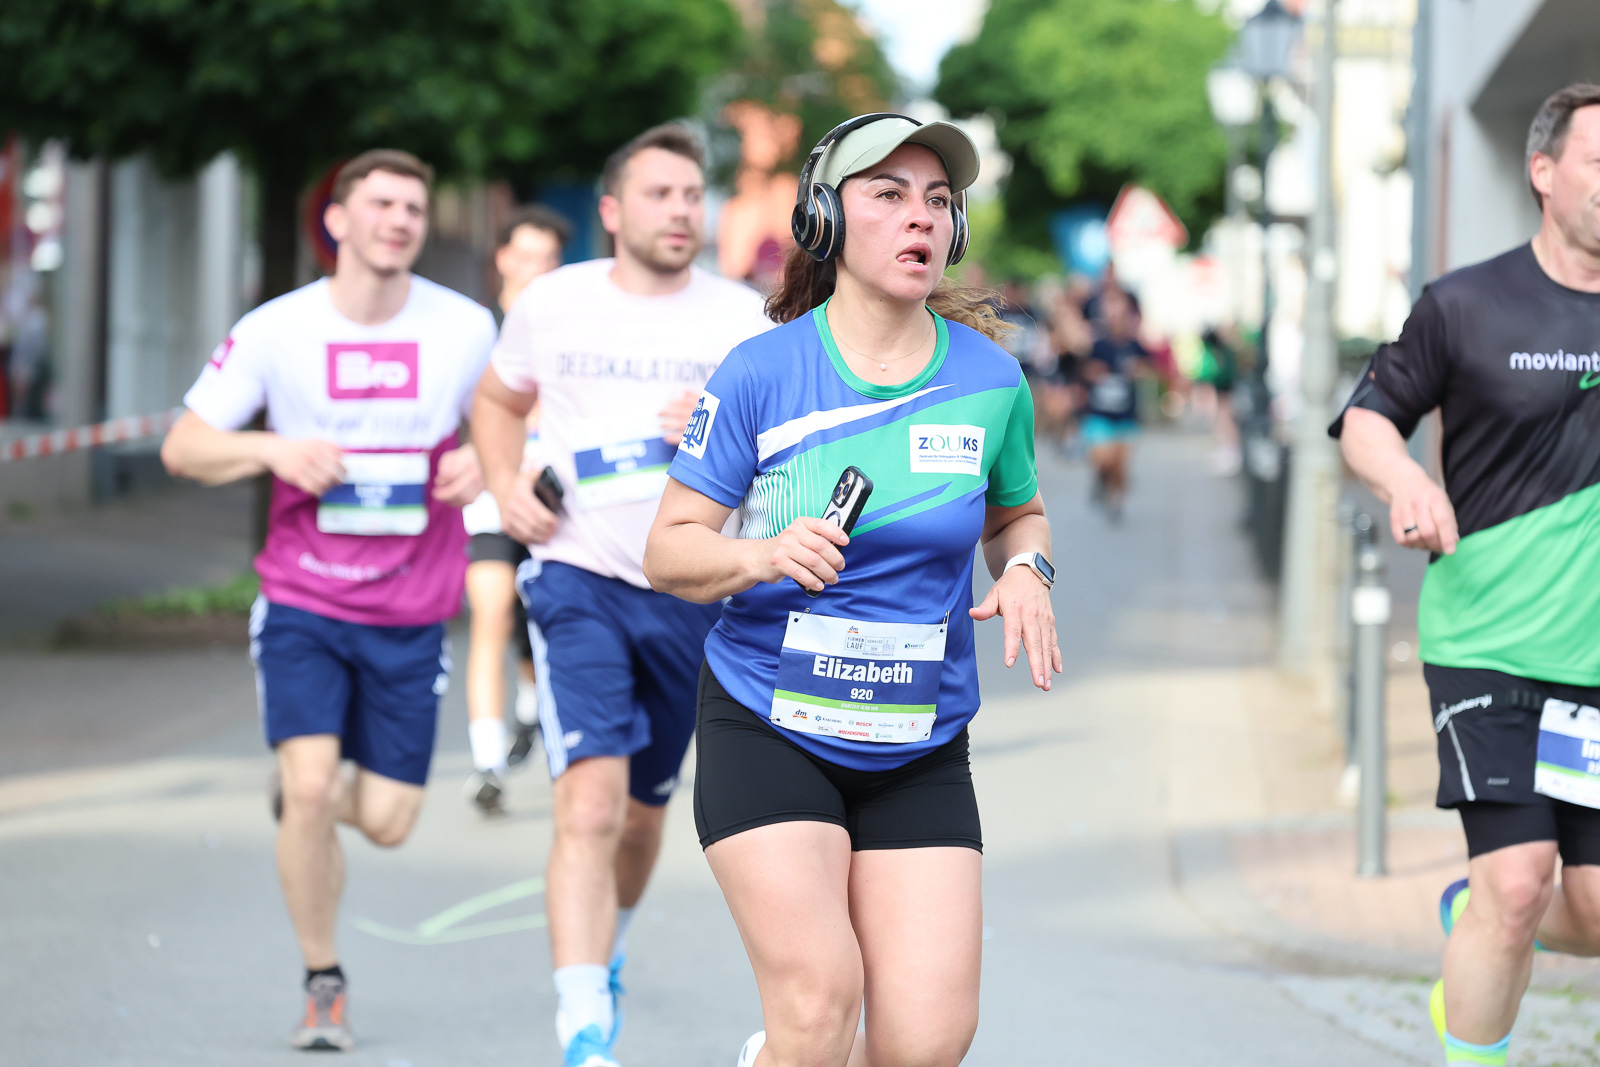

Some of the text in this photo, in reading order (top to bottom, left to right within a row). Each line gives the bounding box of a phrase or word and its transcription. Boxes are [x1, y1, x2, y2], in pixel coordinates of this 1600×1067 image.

[918, 434, 978, 452] ZOUKS
[846, 641, 863, 650] LAUF
[812, 655, 914, 684] Elizabeth
[850, 688, 874, 701] 920
[794, 708, 808, 718] dm
